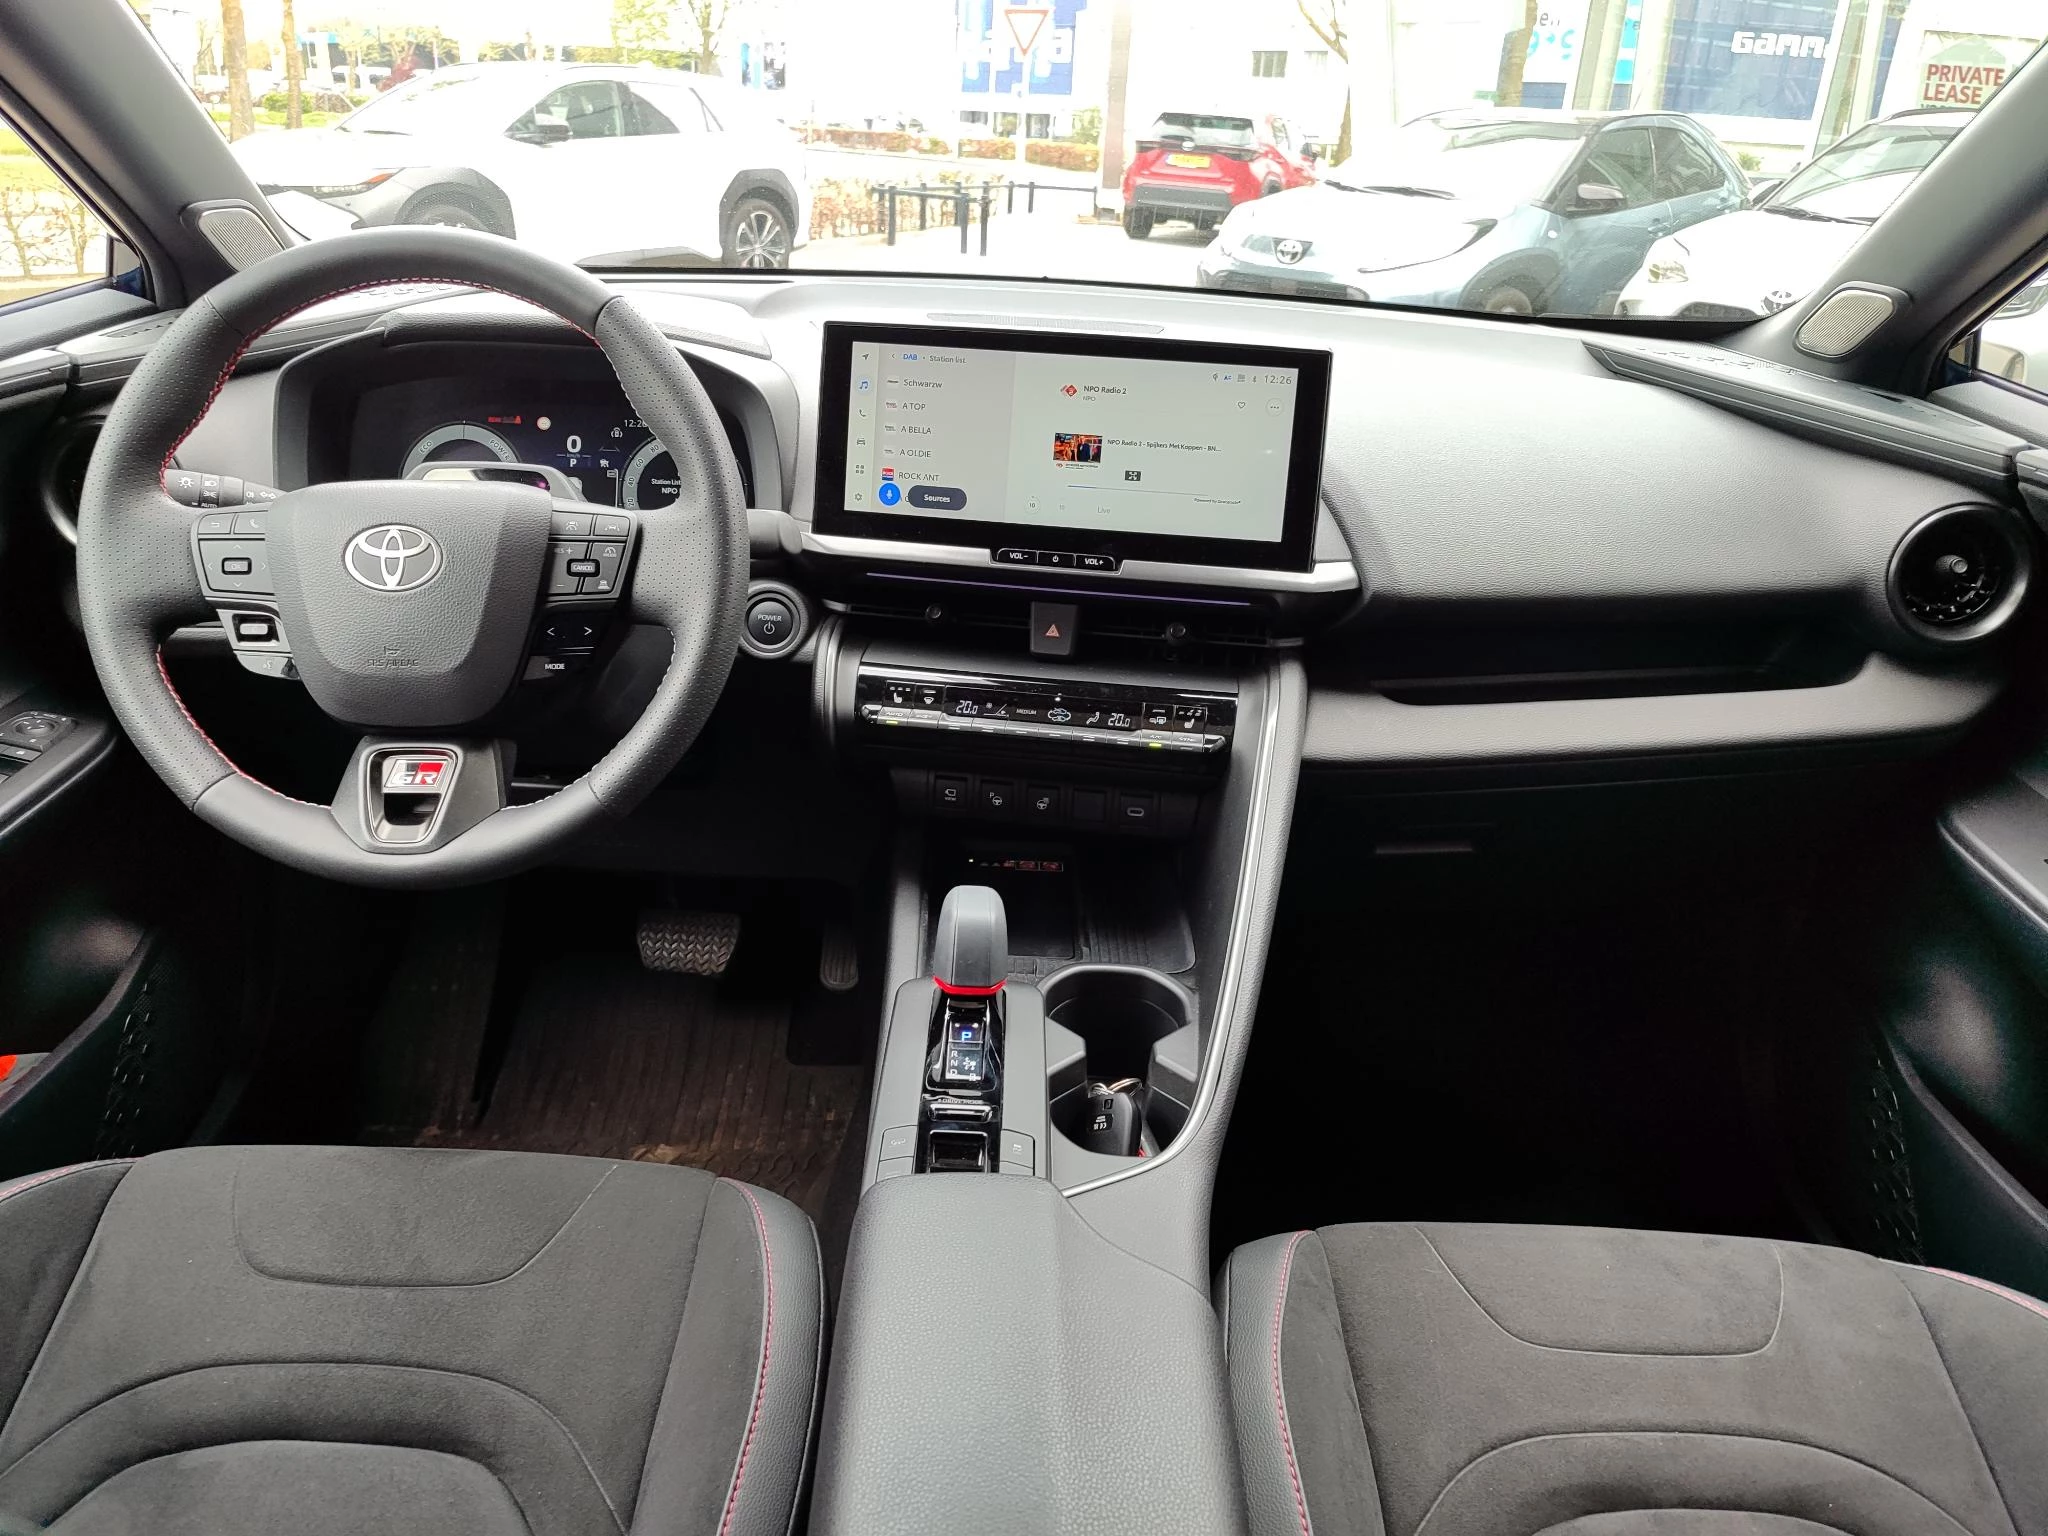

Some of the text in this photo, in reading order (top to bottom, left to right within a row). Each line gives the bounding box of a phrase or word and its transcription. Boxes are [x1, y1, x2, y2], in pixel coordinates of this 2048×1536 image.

[1926, 63, 2006, 86] PRIVATE
[1923, 83, 1983, 104] LEASE
[903, 353, 918, 361] DAB
[929, 355, 954, 363] Station
[903, 378, 942, 389] Schwarzw
[1264, 374, 1292, 385] 12:26
[1083, 385, 1100, 393] NPO
[1101, 386, 1121, 394] Radio
[902, 402, 908, 410] A
[909, 403, 926, 411] TOP
[900, 425, 907, 434] A
[908, 426, 932, 435] BELLA
[419, 440, 433, 454] ECO
[566, 435, 582, 453] 0
[1169, 442, 1180, 450] Met
[899, 448, 906, 457] A
[569, 458, 577, 468] P
[635, 458, 644, 468] 60
[898, 471, 922, 481] ROCK
[922, 473, 940, 482] ANT
[627, 477, 635, 487] 40
[661, 487, 678, 495] NPO
[923, 494, 951, 503] Sources
[1097, 505, 1111, 514] Live
[572, 563, 594, 572] CANCEL
[757, 613, 782, 622] POWER
[955, 699, 979, 715] 20.0
[1107, 712, 1131, 728] 20.0
[391, 771, 438, 786] GR
[961, 1031, 972, 1042] P
[951, 1050, 959, 1058] R
[950, 1059, 959, 1067] N
[950, 1068, 958, 1076] D
